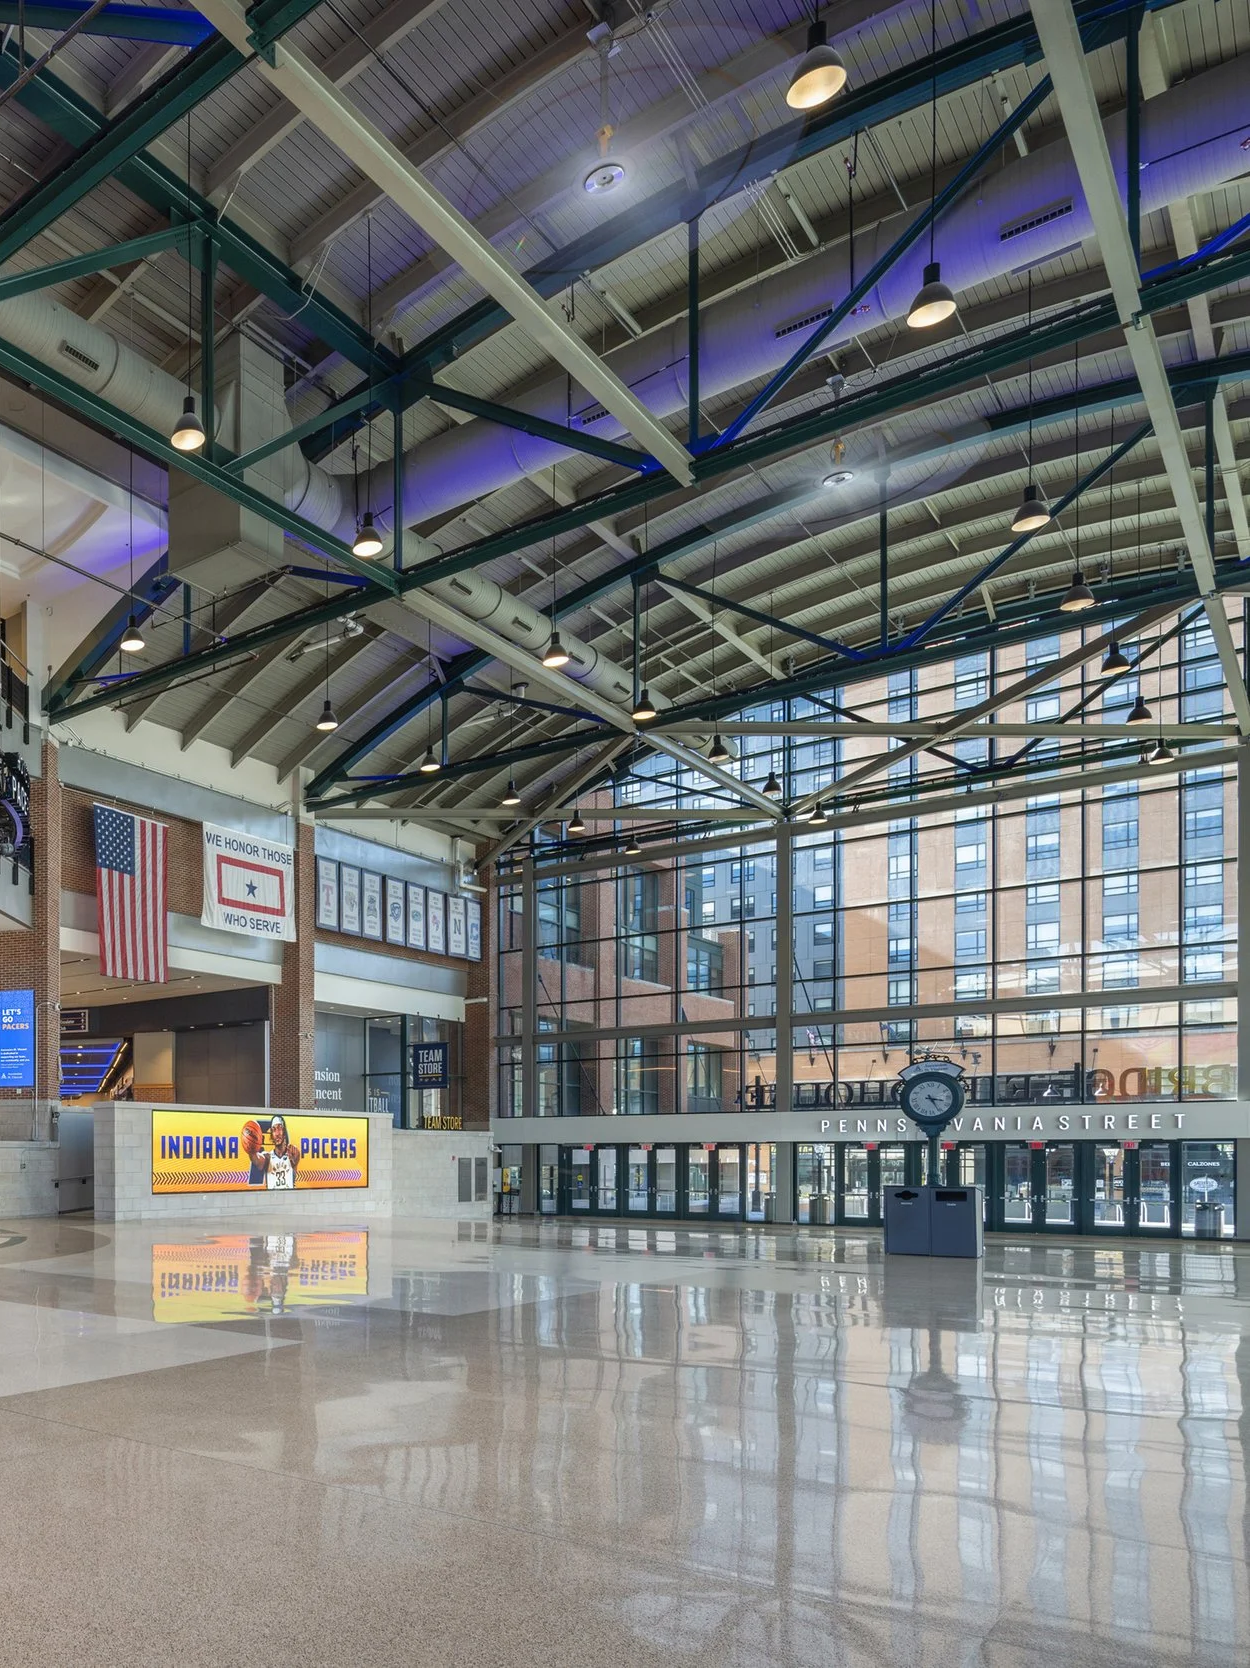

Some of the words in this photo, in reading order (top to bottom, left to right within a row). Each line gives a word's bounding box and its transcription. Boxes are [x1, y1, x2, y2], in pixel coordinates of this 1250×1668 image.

[205, 831, 222, 847] WE
[224, 837, 260, 858] HONOR
[261, 847, 292, 865] THOSE
[223, 912, 248, 928] WHO
[249, 917, 282, 934] SERVE
[2, 1008, 21, 1016] LET'S
[2, 1022, 29, 1030] PACERS
[418, 1048, 443, 1063] TEAM
[418, 1062, 443, 1074] STORE
[424, 1116, 441, 1129] TEAM
[442, 1116, 463, 1130] STORE
[821, 1116, 1044, 1133] PENNSVANIA
[1059, 1113, 1186, 1130] STREET
[161, 1135, 239, 1159] INDIANA
[300, 1137, 357, 1159] PACERS
[275, 1169, 286, 1187] 33
